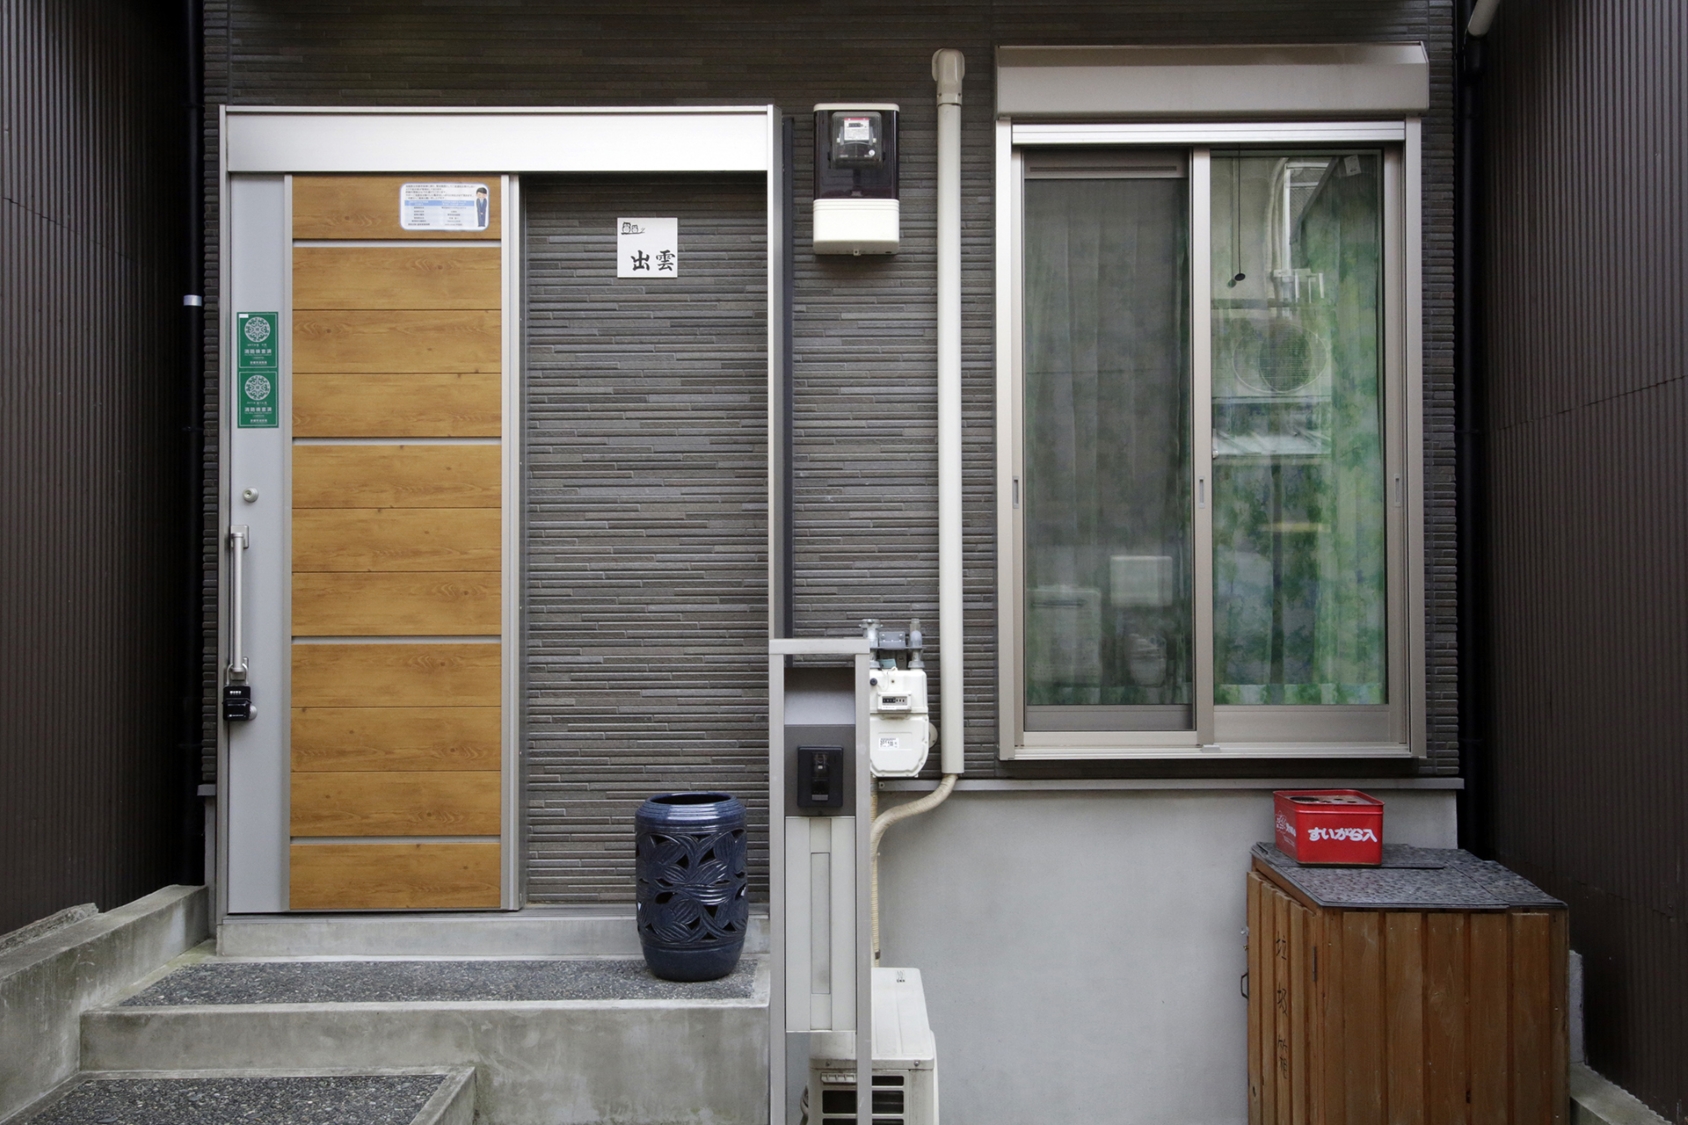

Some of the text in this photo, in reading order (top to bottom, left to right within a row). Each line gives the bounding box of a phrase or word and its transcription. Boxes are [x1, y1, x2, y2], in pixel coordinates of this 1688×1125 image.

[630, 249, 676, 272] 出雲
[1307, 826, 1378, 843] すいがら入
